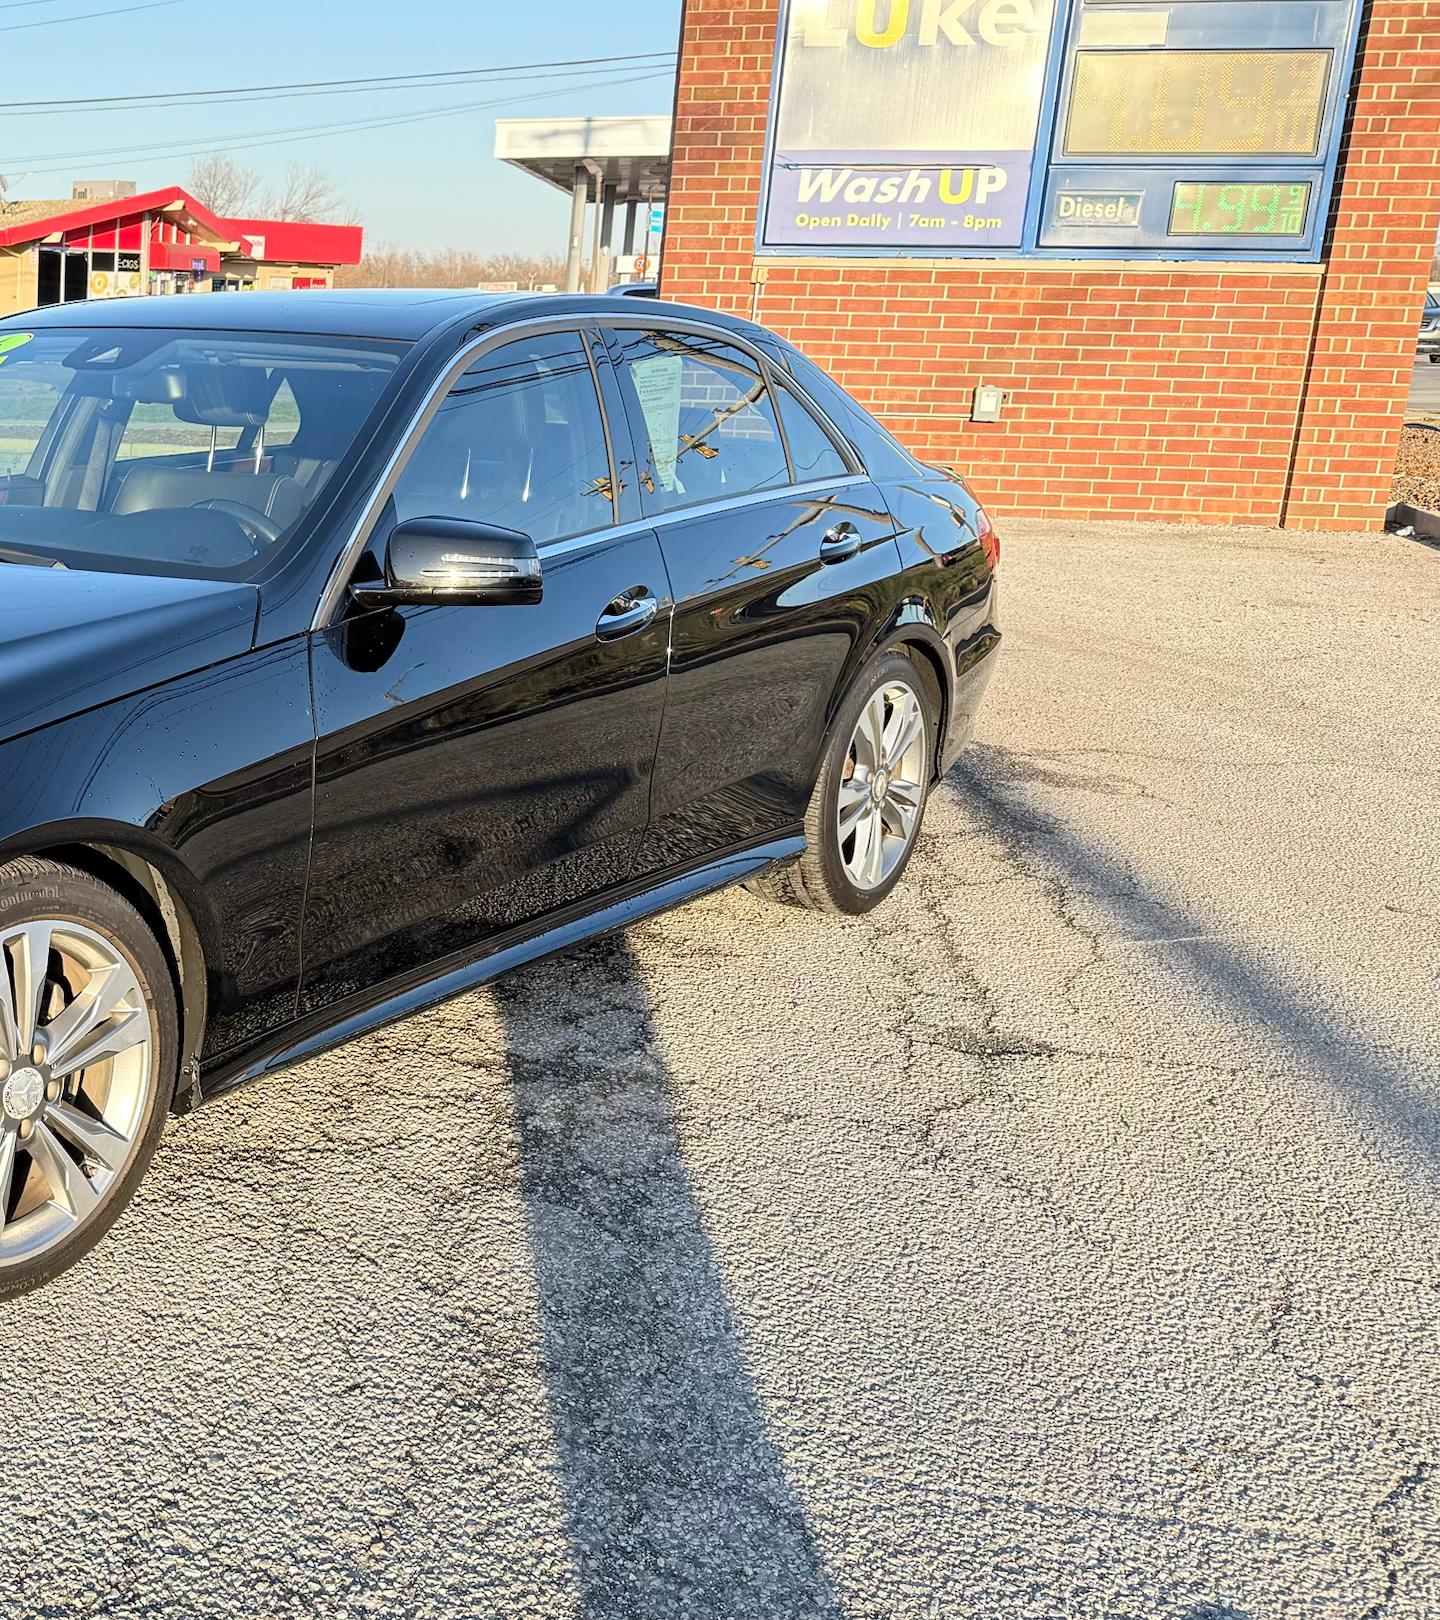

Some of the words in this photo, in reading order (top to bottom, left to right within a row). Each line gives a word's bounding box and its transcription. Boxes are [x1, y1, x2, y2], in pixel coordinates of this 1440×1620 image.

[1058, 196, 1125, 218] Diesel
[1175, 184, 1281, 233] 4.99
[794, 212, 842, 230] Open
[845, 213, 892, 231] Daily
[909, 213, 946, 229] 7am
[962, 214, 1003, 231] 8pm
